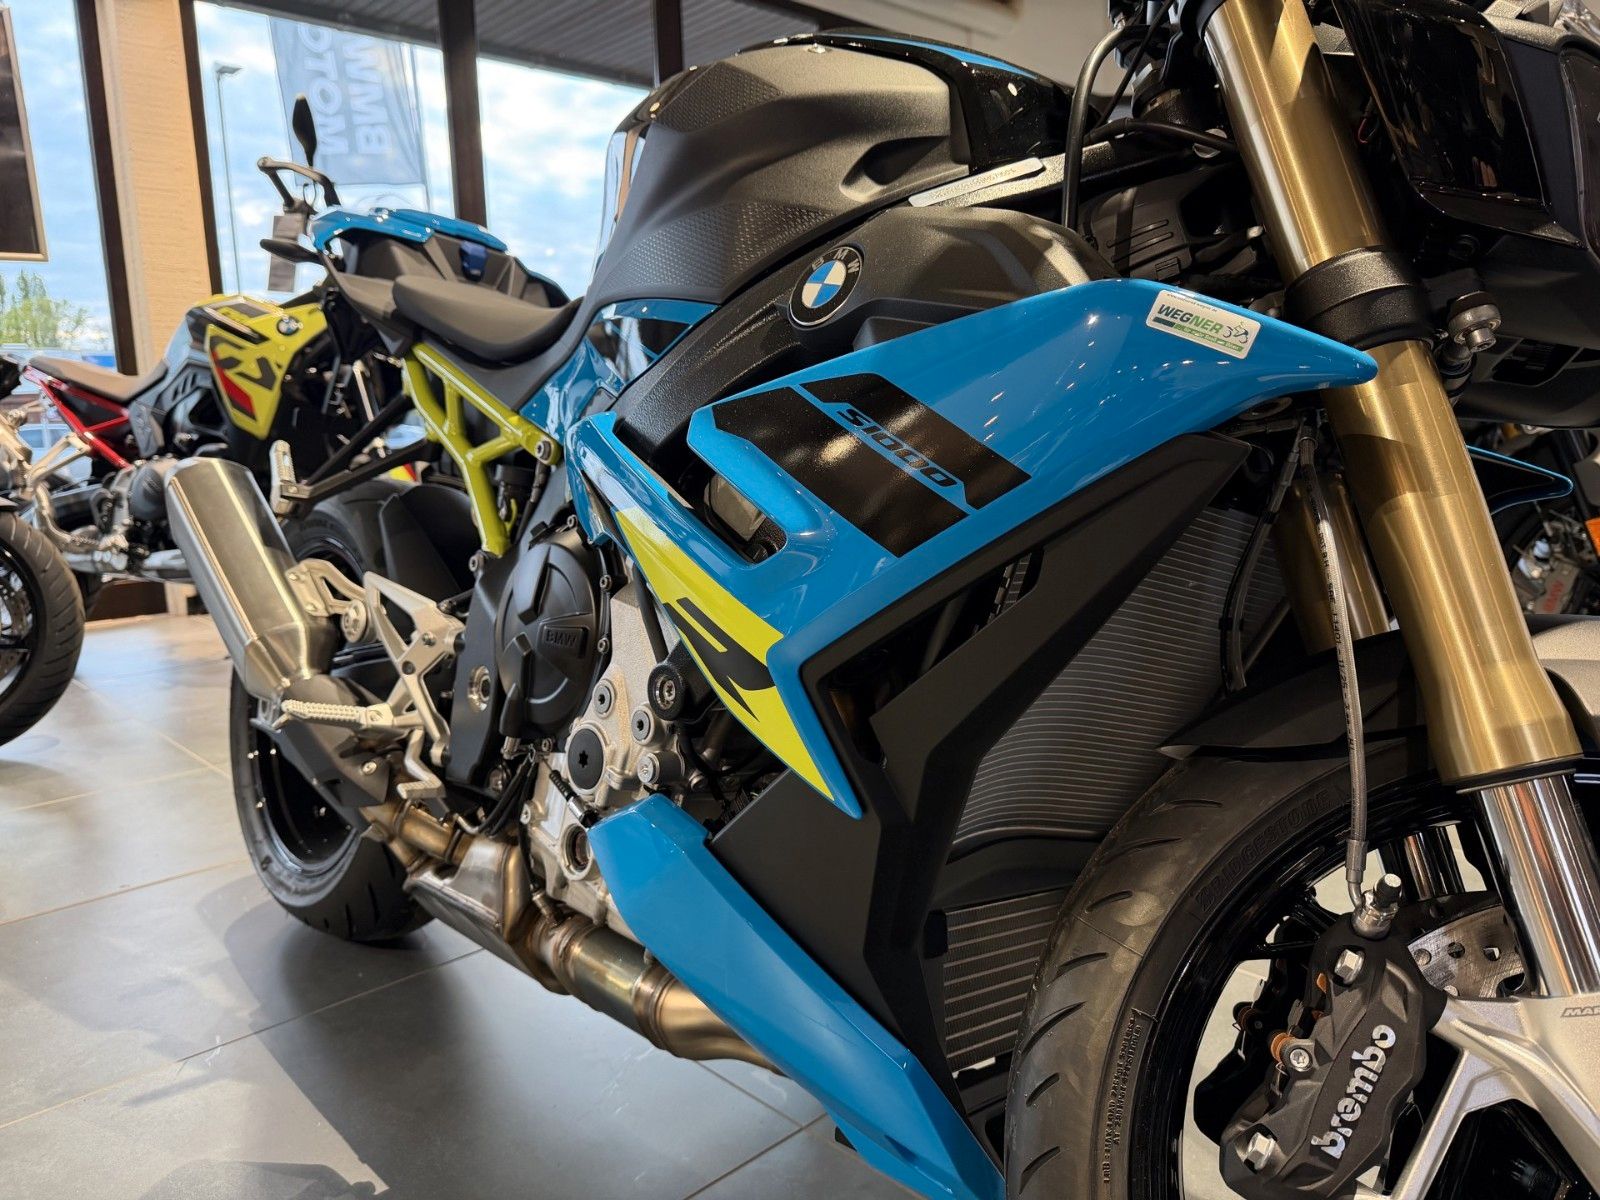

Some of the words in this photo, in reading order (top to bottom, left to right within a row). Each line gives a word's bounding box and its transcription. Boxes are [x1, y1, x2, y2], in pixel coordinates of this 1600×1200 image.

[811, 248, 860, 274] BMW
[1157, 303, 1224, 335] WEGNER
[836, 408, 958, 487] S1000
[545, 628, 577, 647] BMW
[1310, 1024, 1396, 1160] brembo
